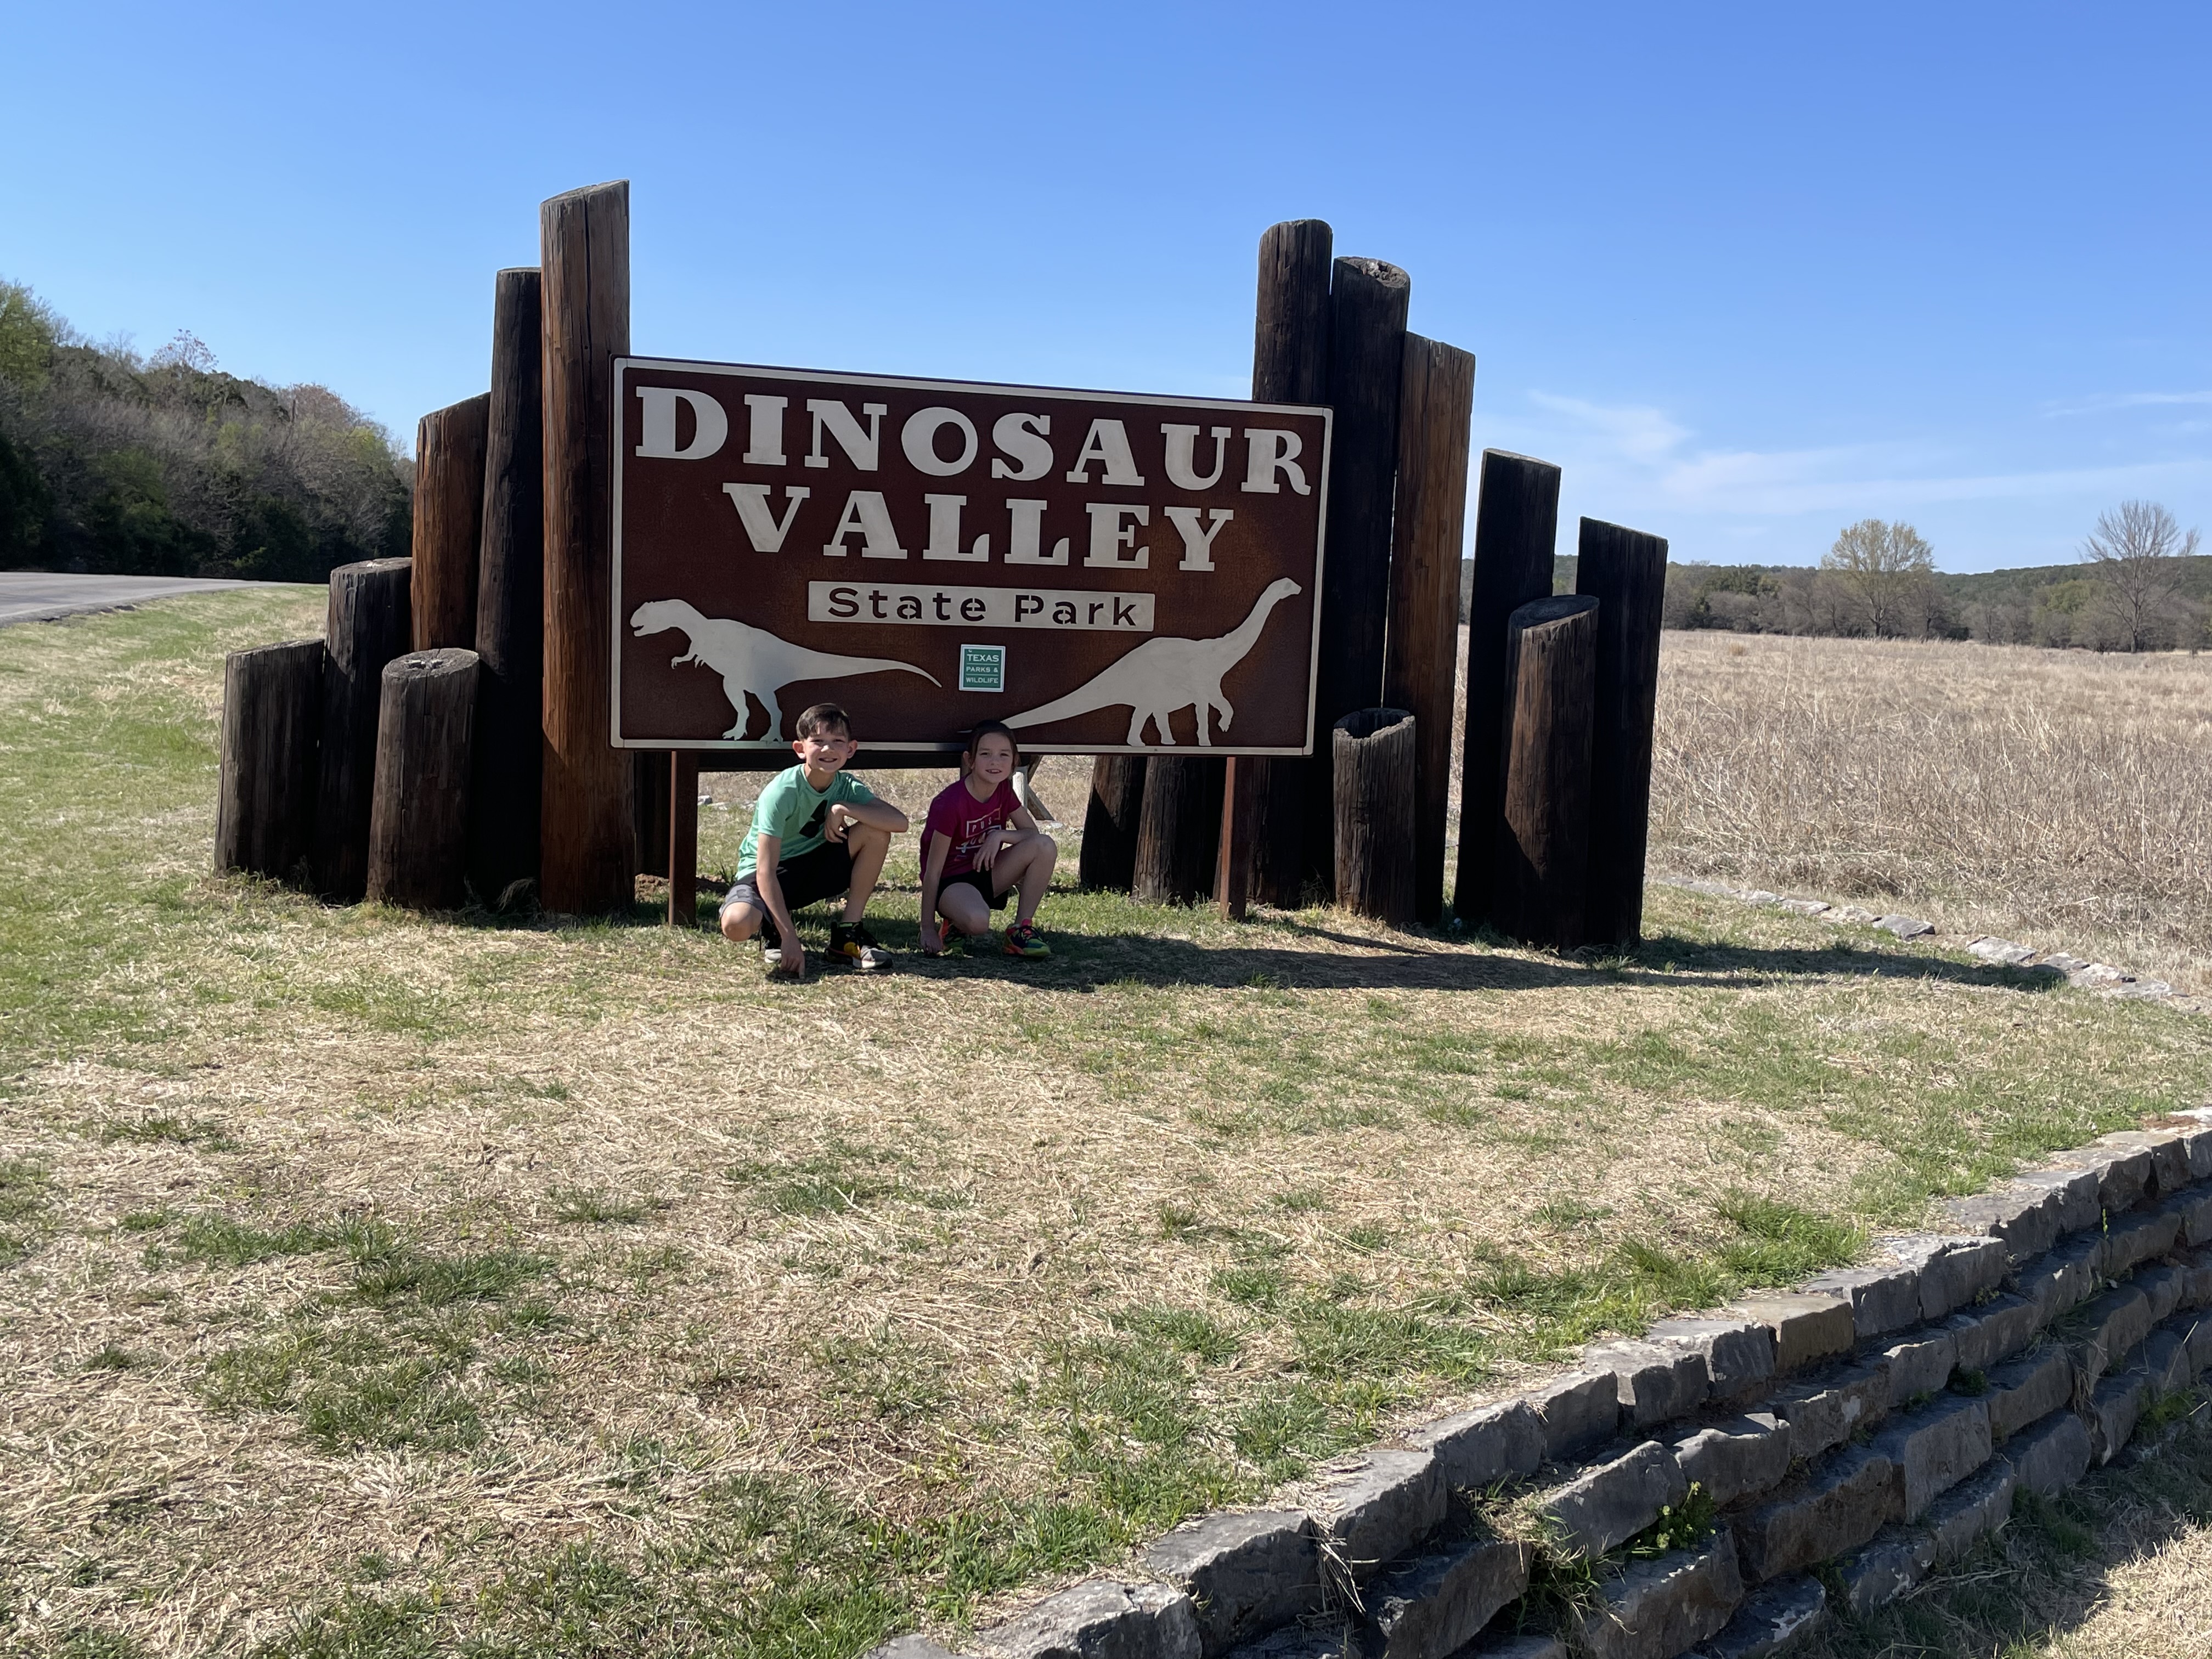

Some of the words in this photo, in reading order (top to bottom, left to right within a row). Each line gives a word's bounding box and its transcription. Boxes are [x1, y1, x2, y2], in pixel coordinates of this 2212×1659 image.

[636, 386, 1311, 495] DINOSAUR
[723, 483, 1234, 572] VALLEY
[828, 587, 986, 622] State
[1014, 594, 1137, 627] Park
[967, 653, 999, 662] TEXAS
